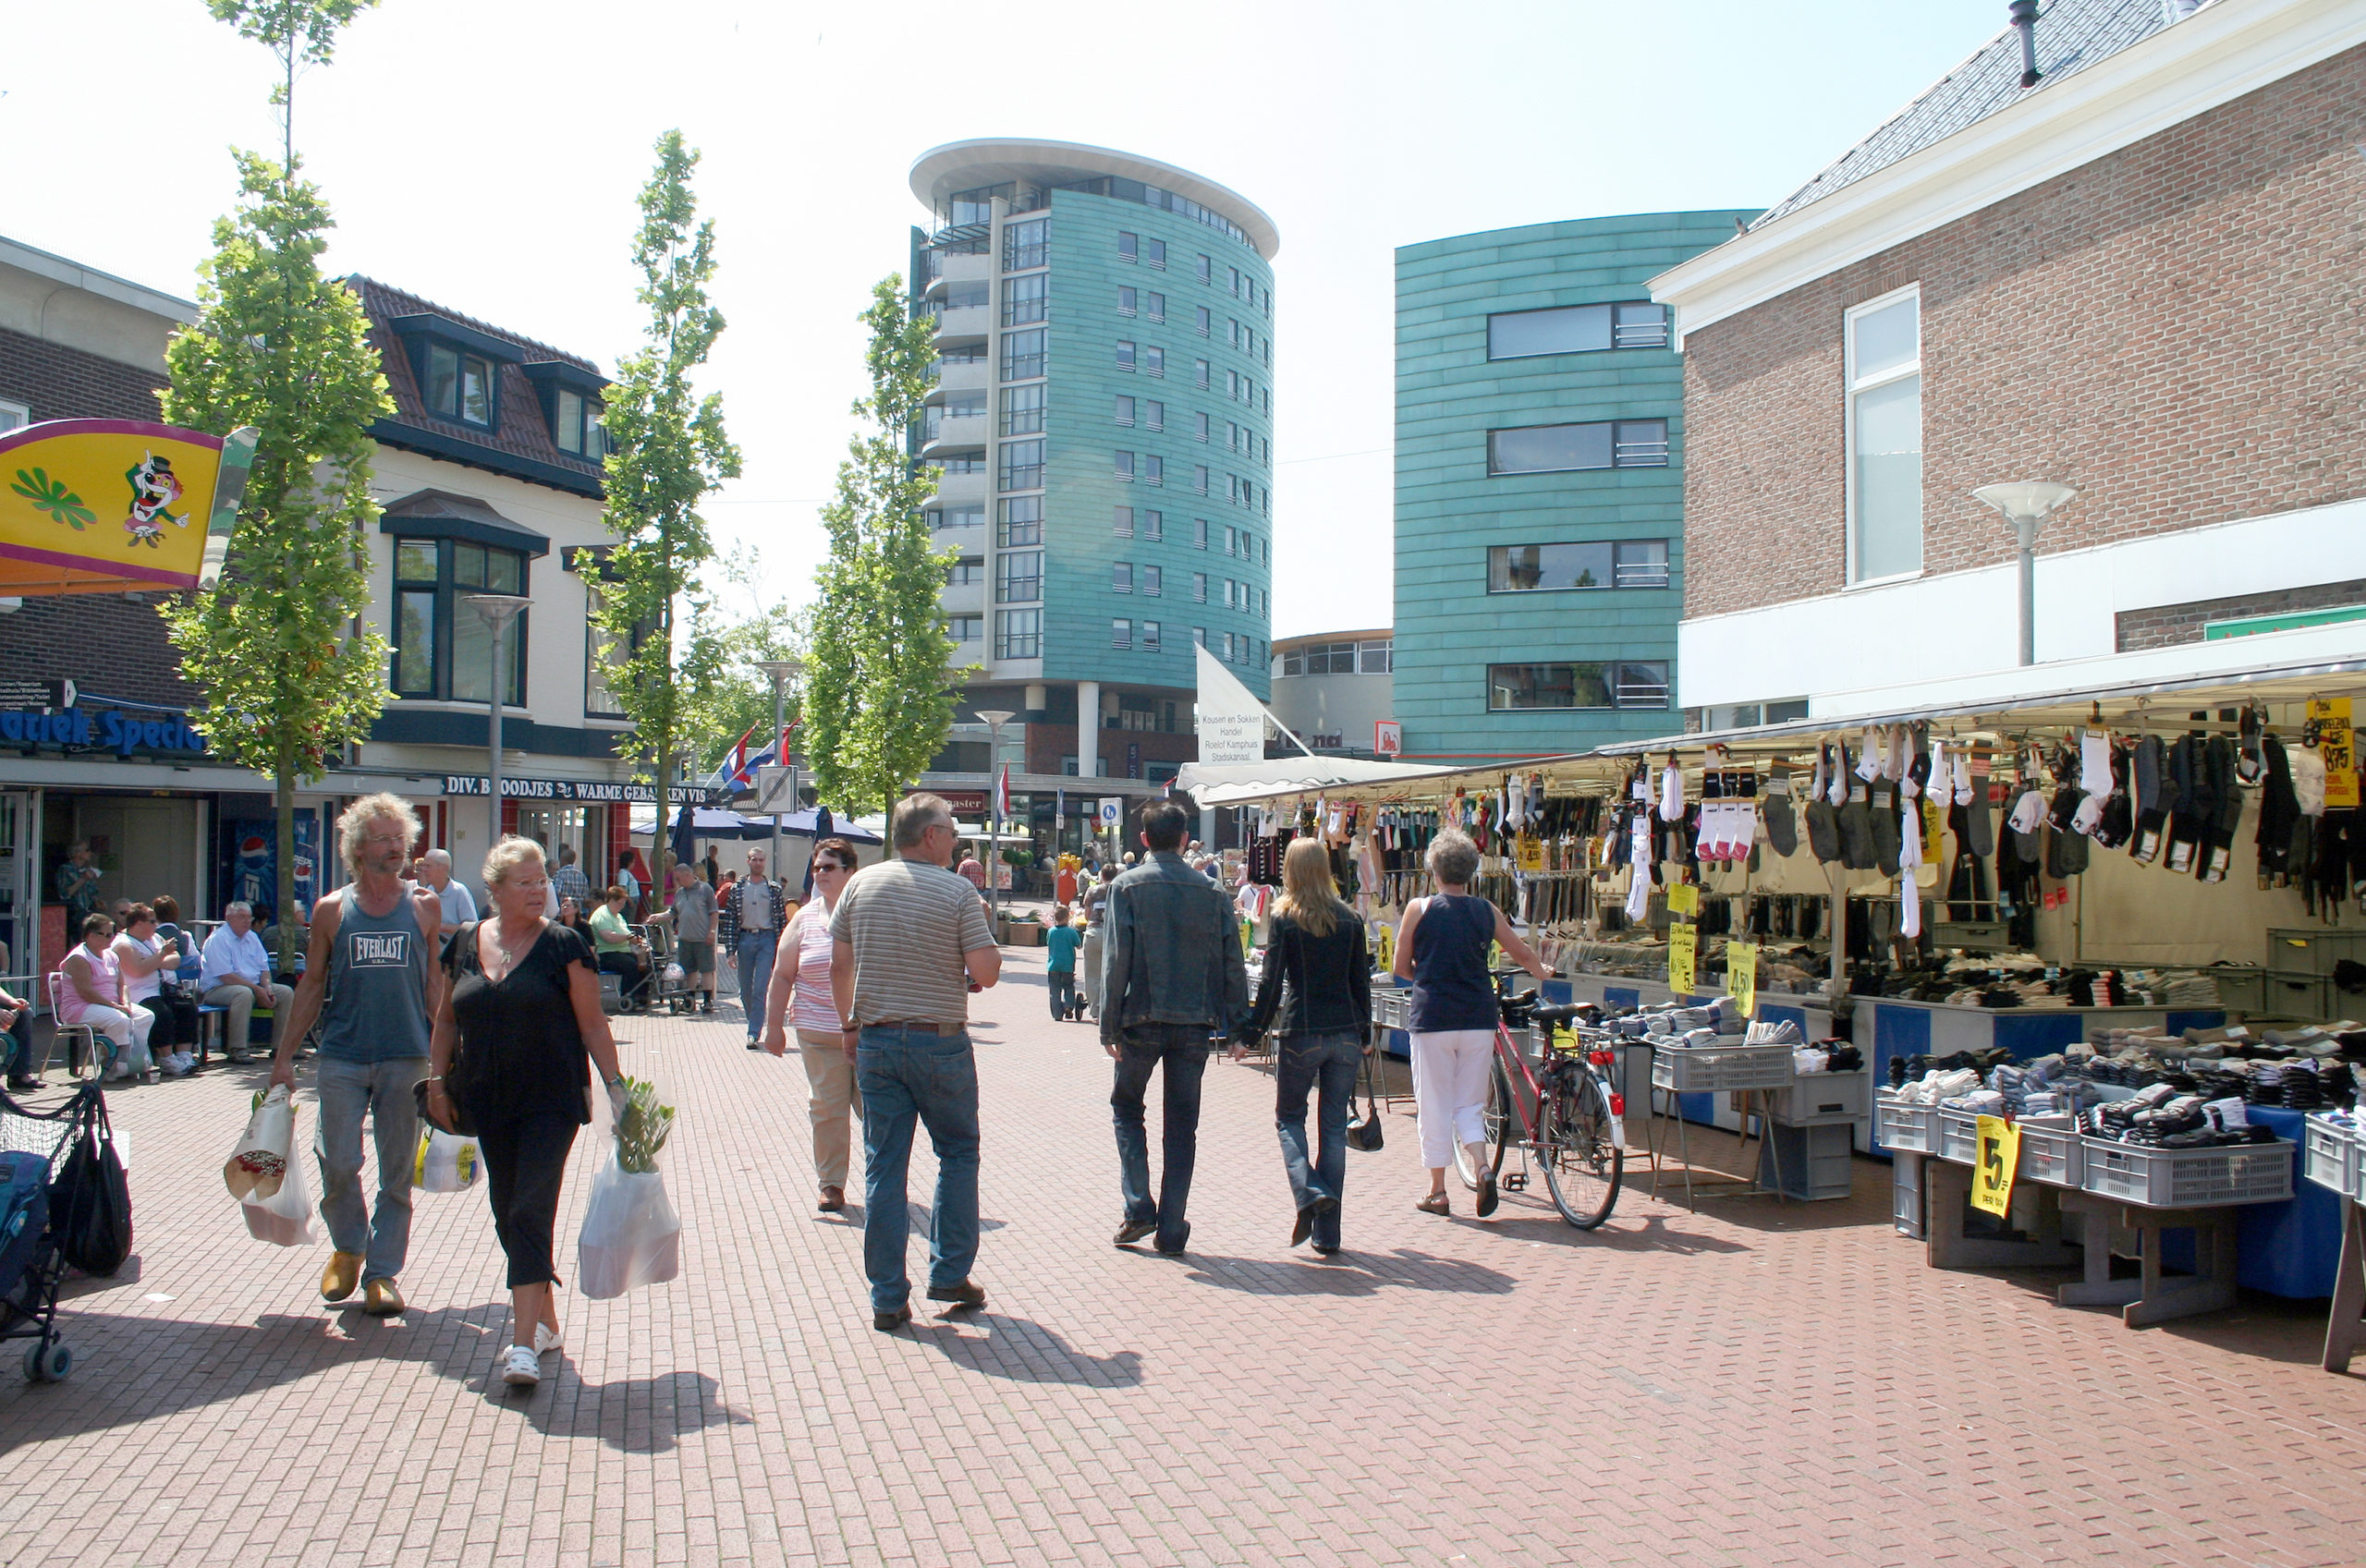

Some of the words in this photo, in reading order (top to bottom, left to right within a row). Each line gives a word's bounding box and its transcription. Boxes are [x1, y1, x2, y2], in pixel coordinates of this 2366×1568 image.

[1202, 715, 1226, 724] Kousen
[1237, 714, 1261, 724] Sokken
[0, 707, 91, 745] atiek
[1220, 727, 1242, 736] Handel
[1205, 740, 1225, 749] Roelof
[1226, 740, 1258, 750] Kamphuis
[447, 776, 478, 794] DIV.
[481, 778, 555, 797] BOODJES
[576, 784, 622, 800] WARME
[624, 785, 687, 802] GEBAKEN
[689, 788, 706, 803] VIS
[949, 799, 982, 808] aster
[356, 935, 404, 962] EVERLAST
